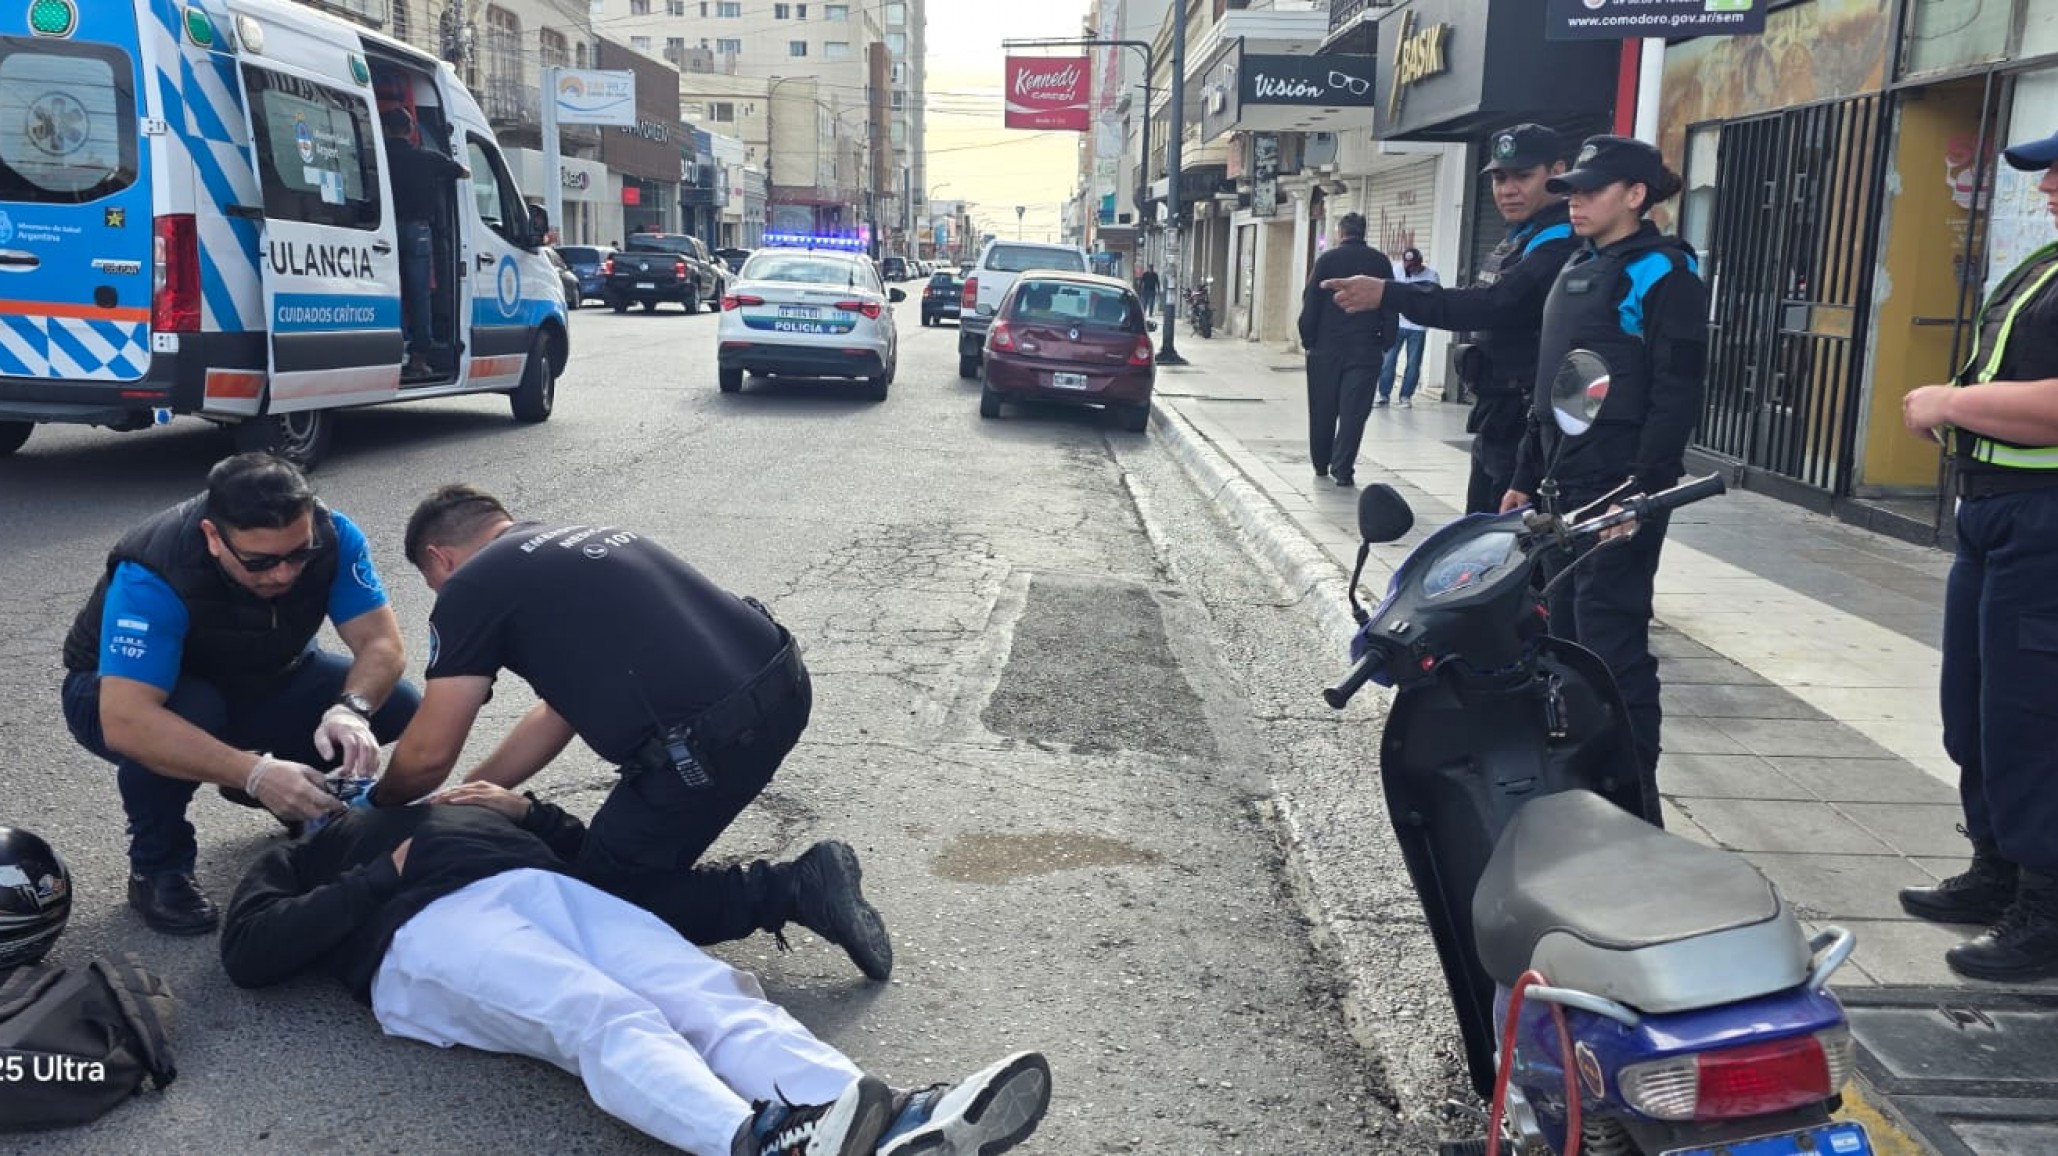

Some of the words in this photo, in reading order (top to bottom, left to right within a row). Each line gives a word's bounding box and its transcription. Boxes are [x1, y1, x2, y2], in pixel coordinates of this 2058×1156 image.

[1568, 12, 1744, 26] www.comodoro.gov.ar/sem
[1015, 64, 1081, 96] Kennedy
[1255, 72, 1325, 98] Visión
[278, 306, 332, 322] CUIDADOS
[604, 531, 638, 547] 107
[121, 645, 145, 659] 107
